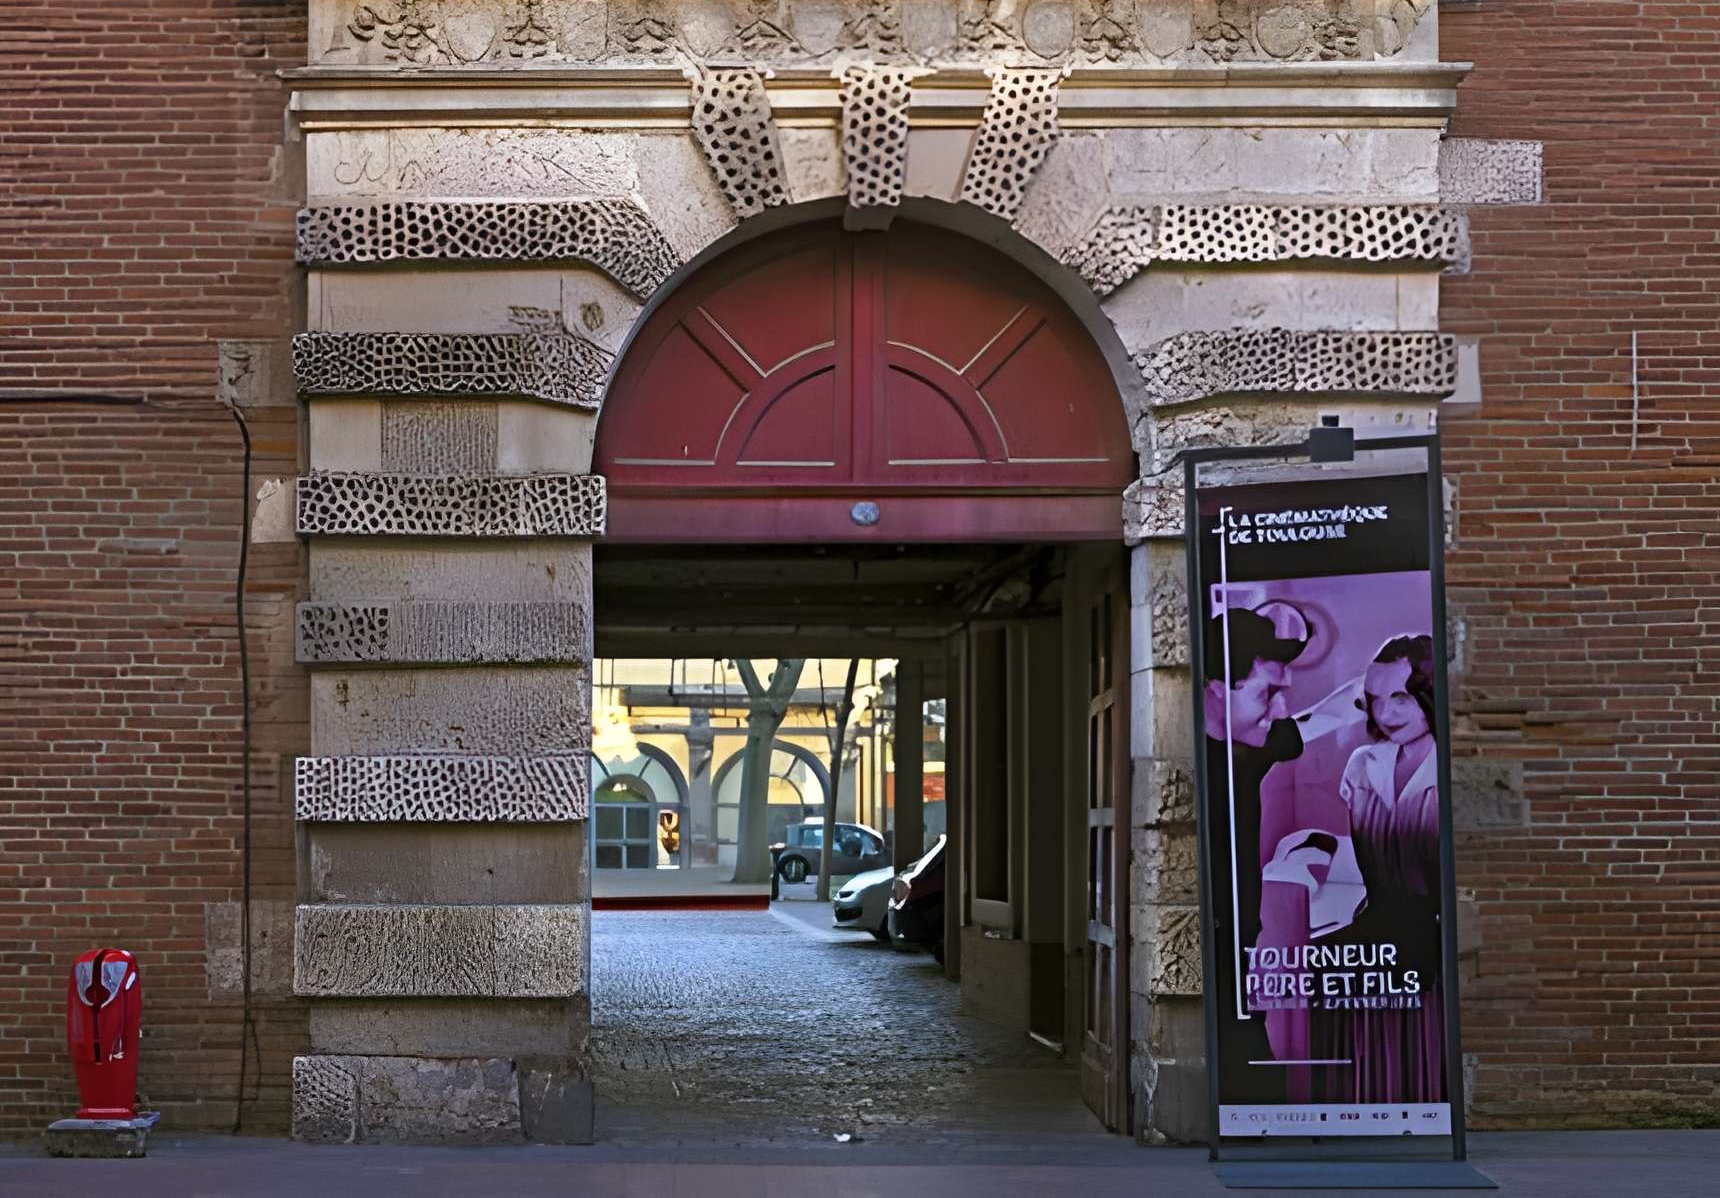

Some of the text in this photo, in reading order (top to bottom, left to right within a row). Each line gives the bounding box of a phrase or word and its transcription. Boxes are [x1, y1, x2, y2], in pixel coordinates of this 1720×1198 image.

[1244, 944, 1398, 970] TOURNEUR
[1322, 973, 1356, 995] ET
[1363, 971, 1421, 995] FILS
